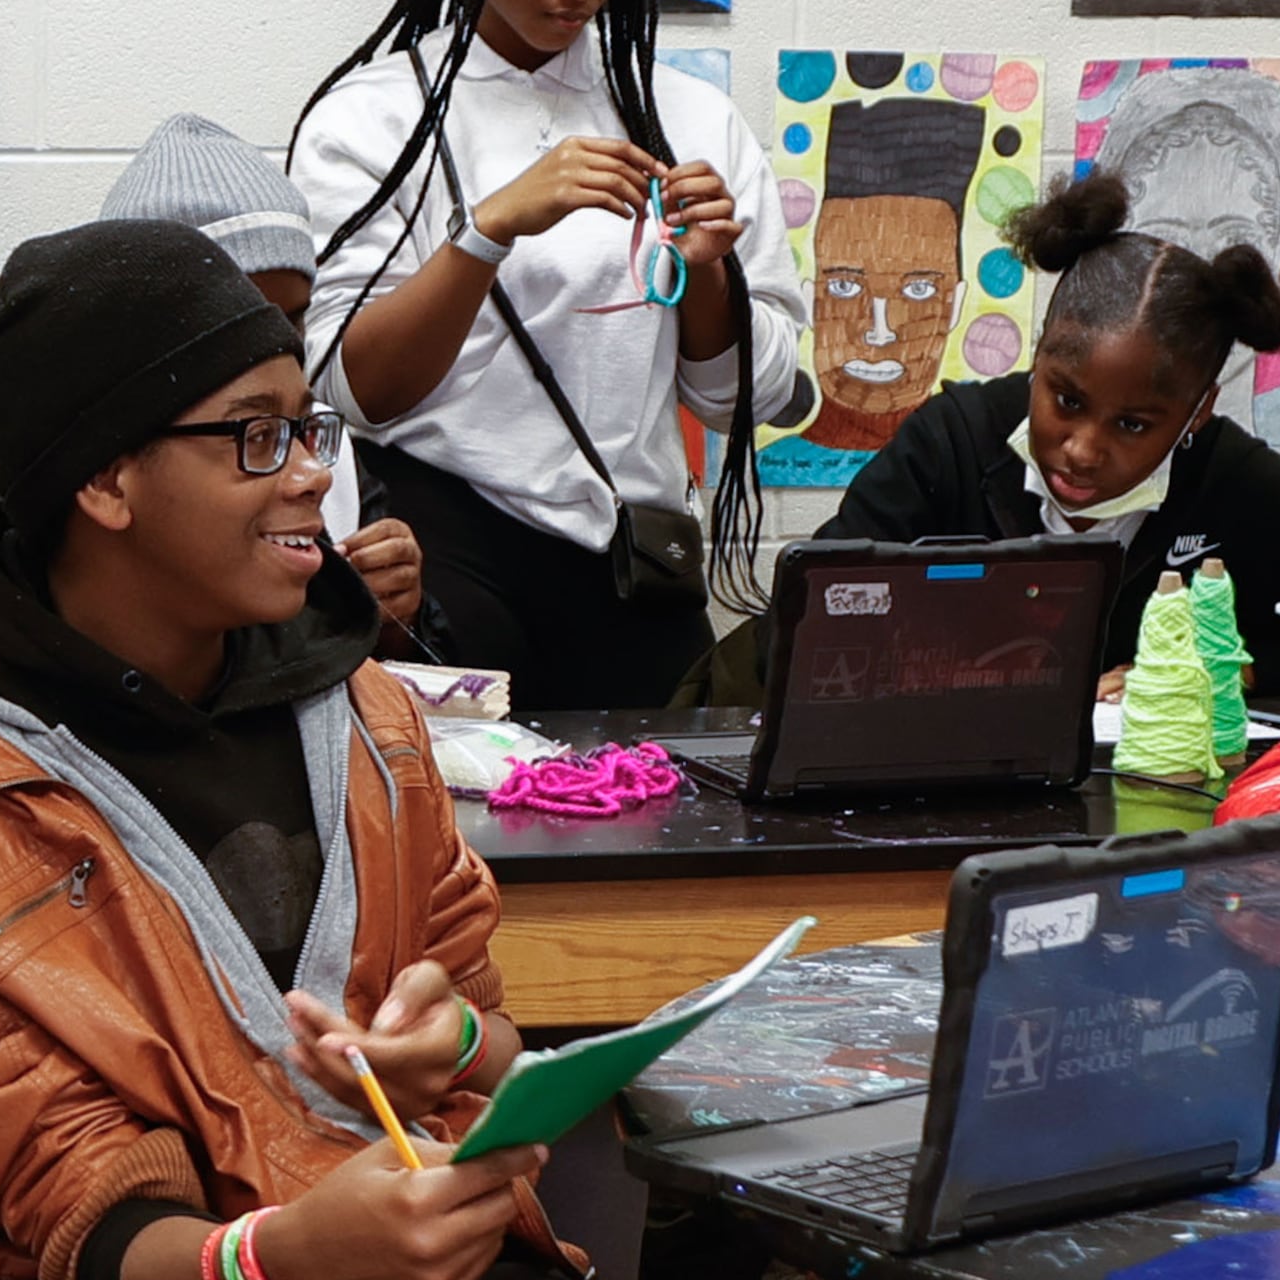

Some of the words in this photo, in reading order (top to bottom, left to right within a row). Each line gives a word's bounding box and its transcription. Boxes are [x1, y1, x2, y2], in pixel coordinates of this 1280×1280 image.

[1173, 534, 1207, 553] NIKE
[1061, 1024, 1136, 1052] PUBLIC
[1055, 1049, 1133, 1080] SCHOOLS
